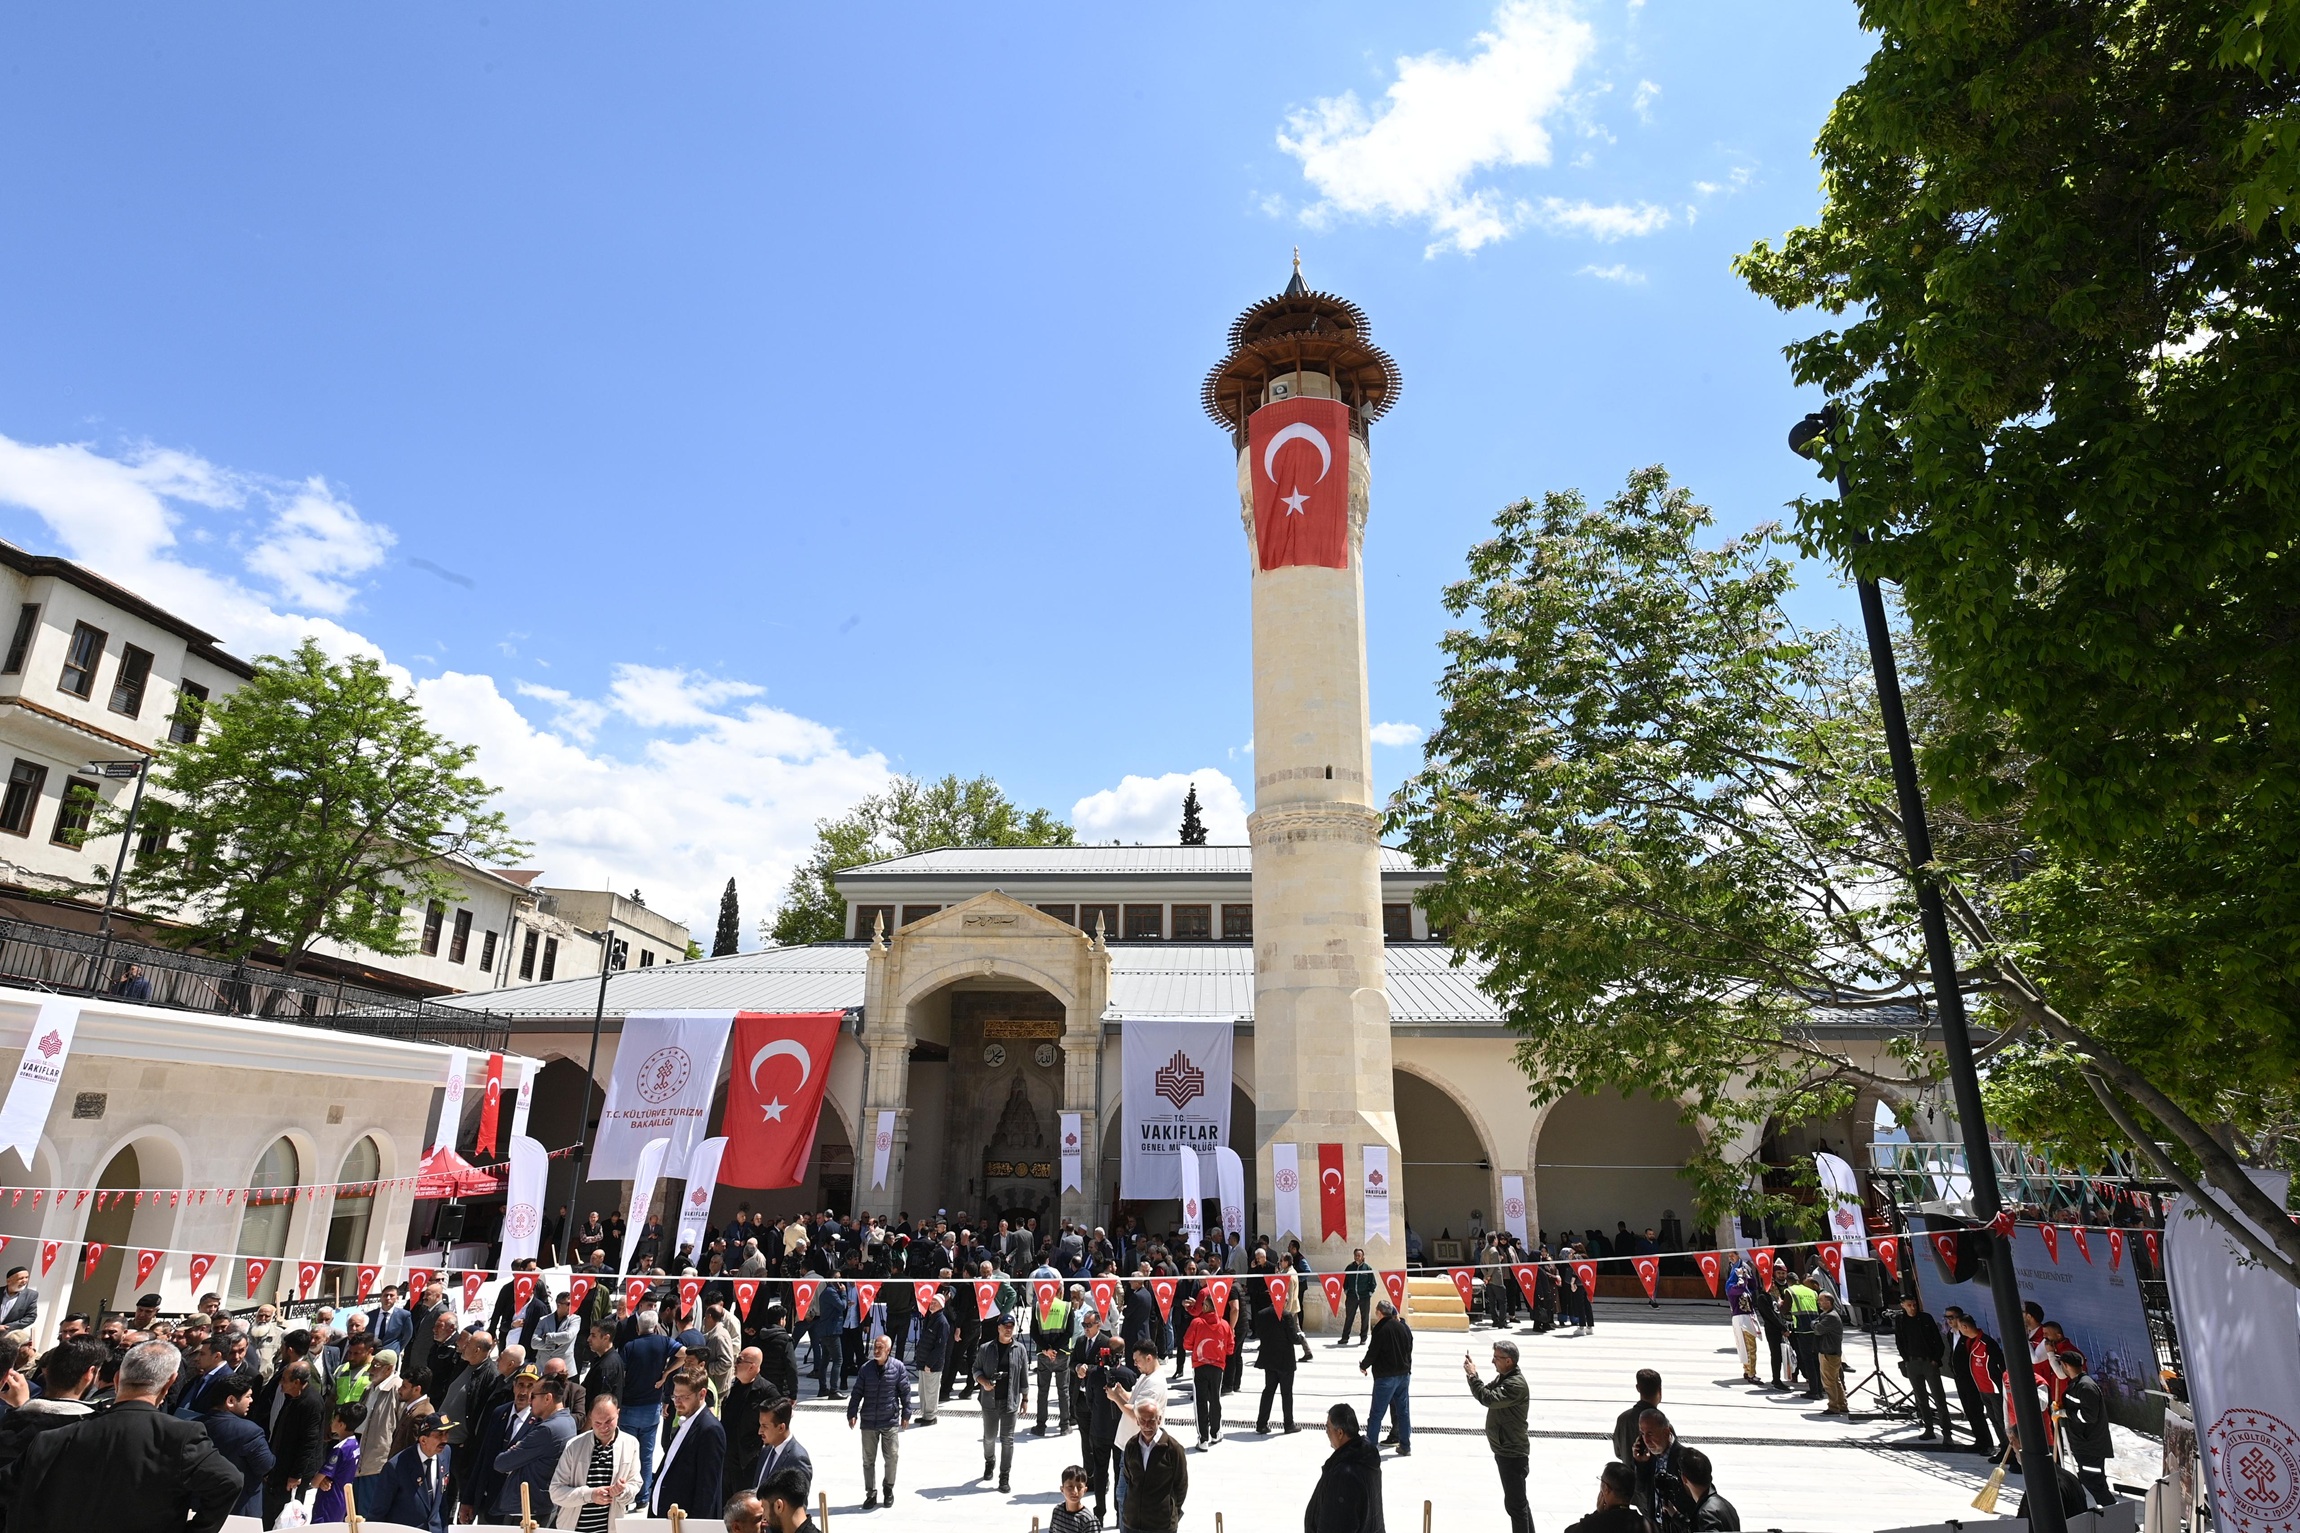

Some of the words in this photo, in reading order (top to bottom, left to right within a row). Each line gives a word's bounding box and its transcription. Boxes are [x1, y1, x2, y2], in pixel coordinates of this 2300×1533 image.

[22, 1062, 60, 1077] VAKIFLAR
[605, 1110, 621, 1119] T.C.
[668, 1106, 703, 1118] TURİZM
[1174, 1114, 1186, 1123] T.C.
[1141, 1123, 1218, 1141] VAKIFLAR
[1141, 1143, 1166, 1152] GENEL
[2273, 1442, 2283, 1454] VE
